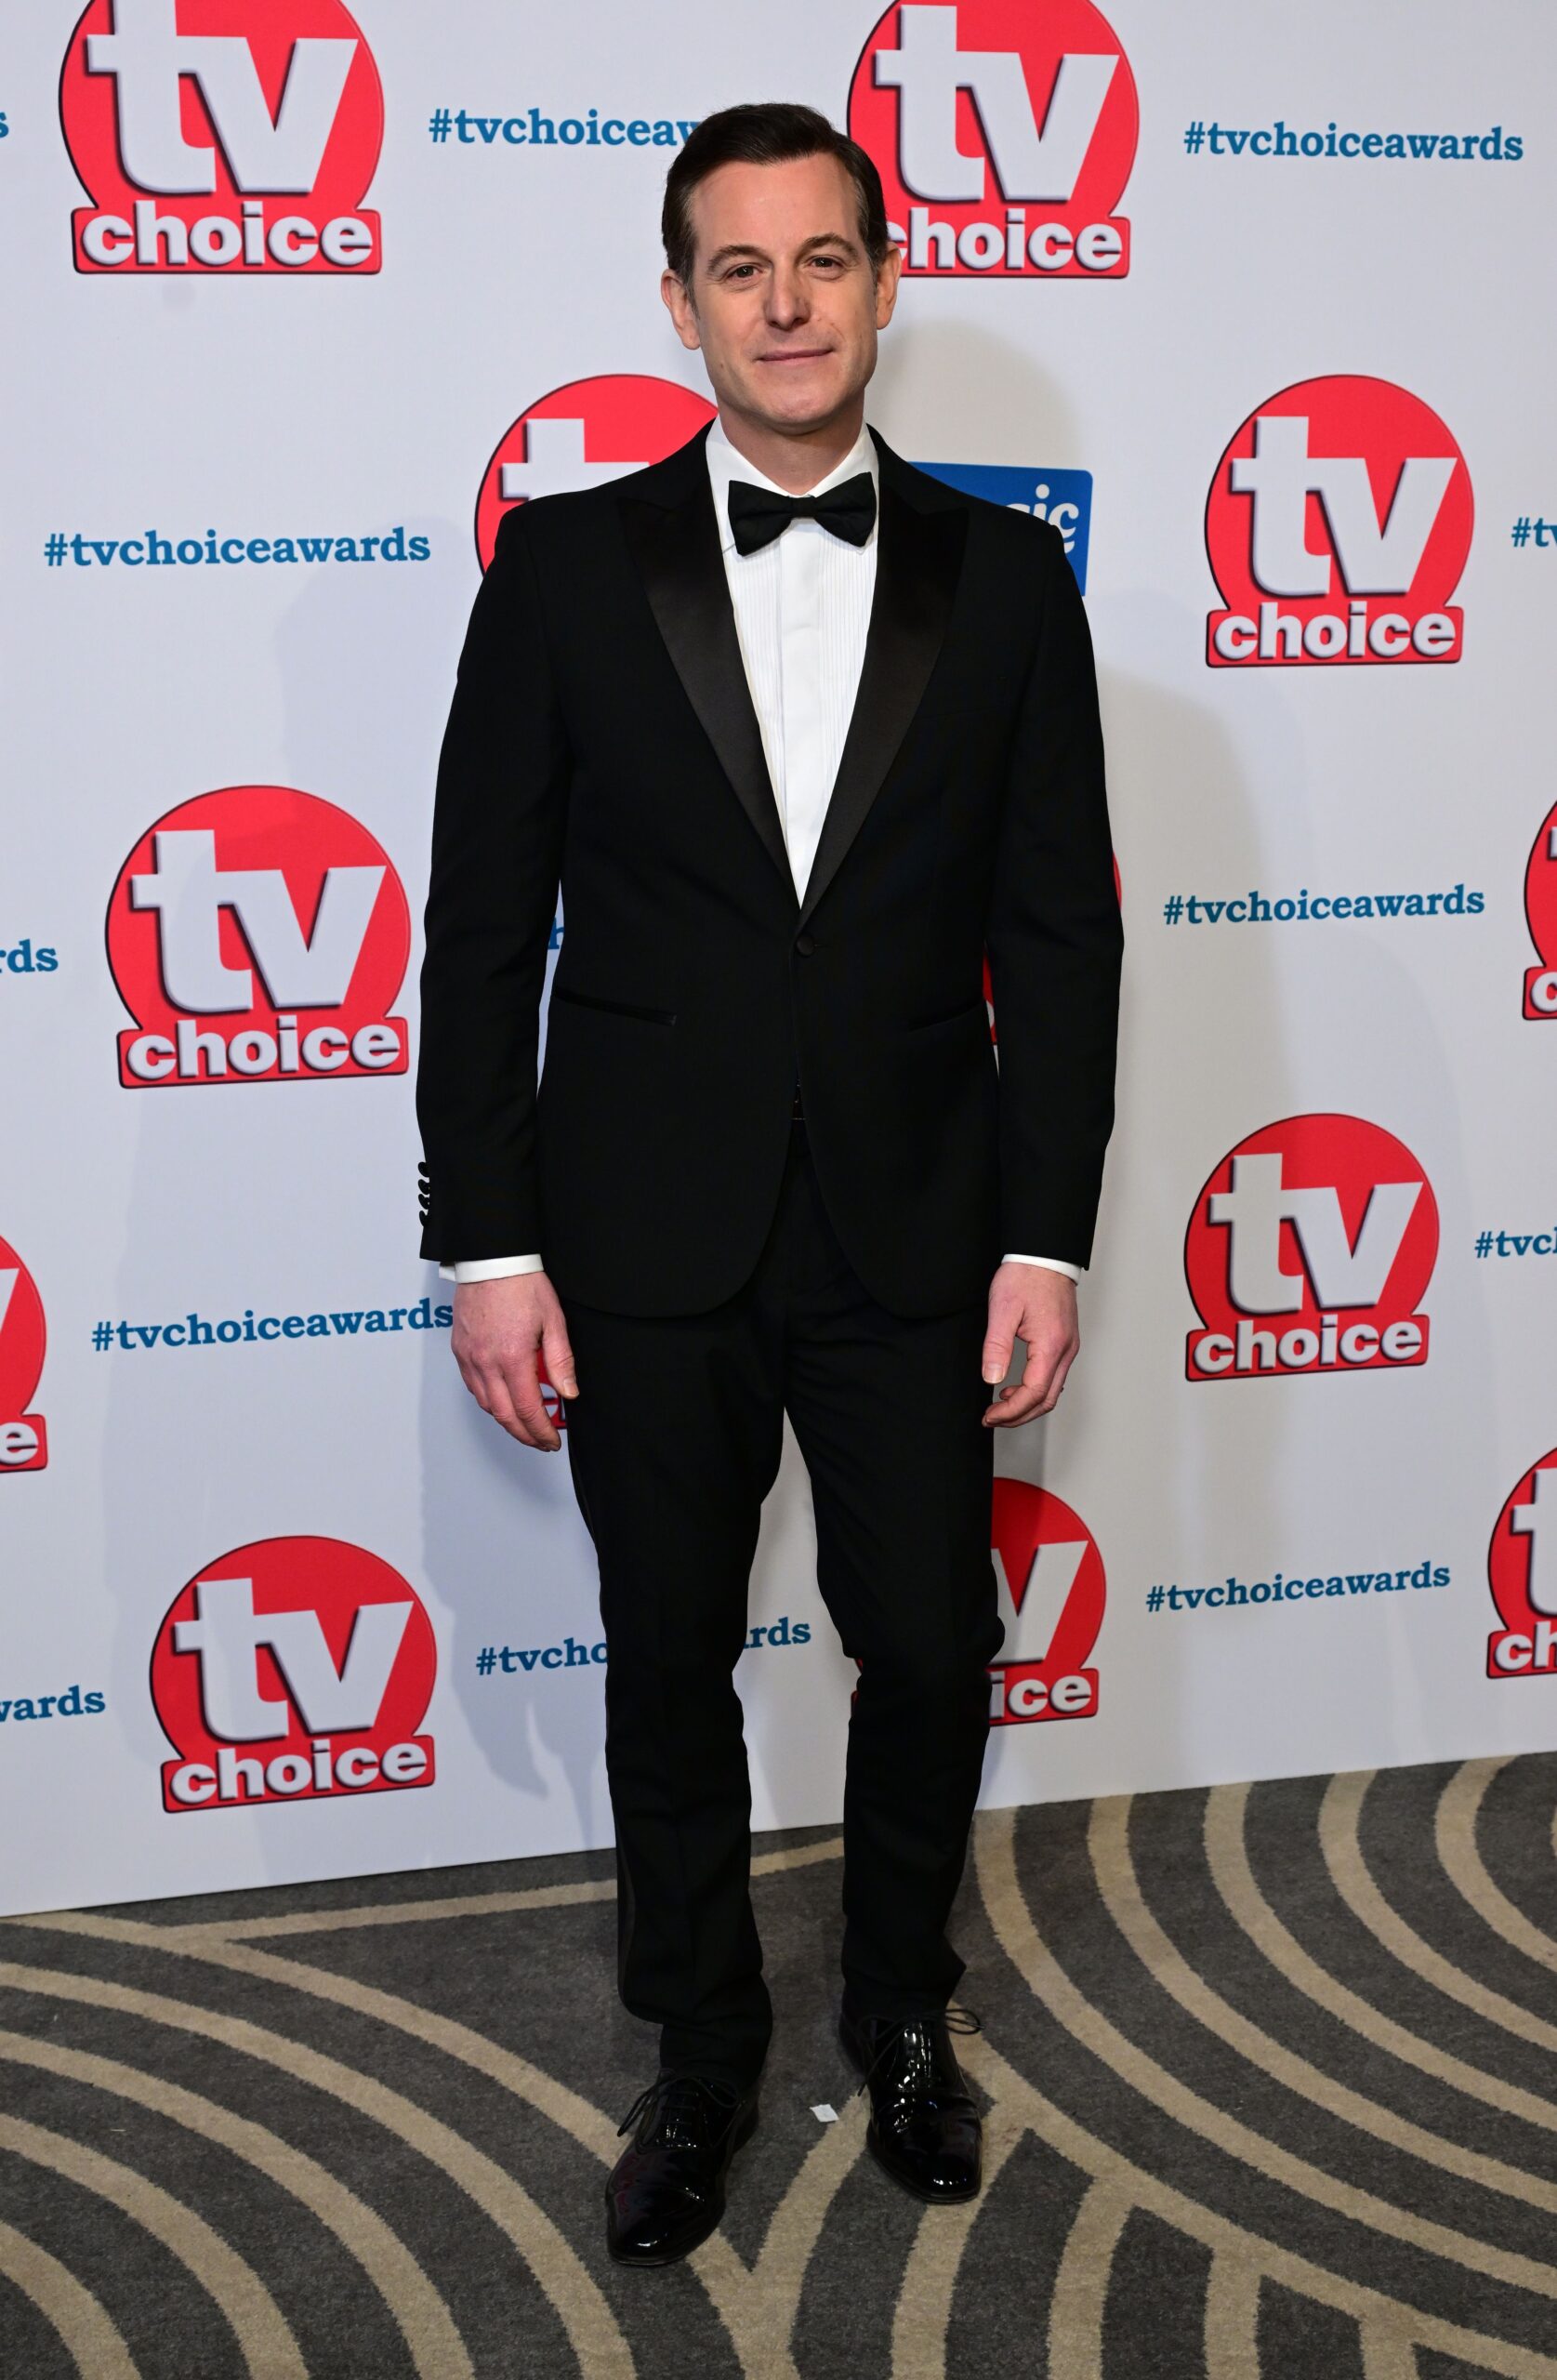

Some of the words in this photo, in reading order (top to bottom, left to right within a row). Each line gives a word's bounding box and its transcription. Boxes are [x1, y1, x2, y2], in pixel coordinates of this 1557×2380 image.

[86, 0, 359, 193] tv
[429, 108, 703, 147] #tvchoicea
[875, 4, 1120, 202] tv
[1183, 121, 1524, 162] #tvchoiceawards
[82, 199, 373, 267] choice
[1232, 416, 1458, 597] tv
[44, 528, 431, 567] #tvchoiceawards
[1213, 602, 1457, 660] choice
[131, 829, 387, 1013] tv
[1164, 884, 1485, 925] #tvchoiceawards
[126, 1015, 401, 1080] choice
[1208, 1153, 1424, 1316] tv
[91, 1298, 454, 1352] #tvchoiceawards
[1193, 1315, 1422, 1374] choice
[991, 1540, 1089, 1665] v
[1146, 1561, 1451, 1613] #tvchoiceawards
[174, 1577, 415, 1743] tv
[989, 1670, 1092, 1718] ice
[169, 1740, 428, 1807] choice
